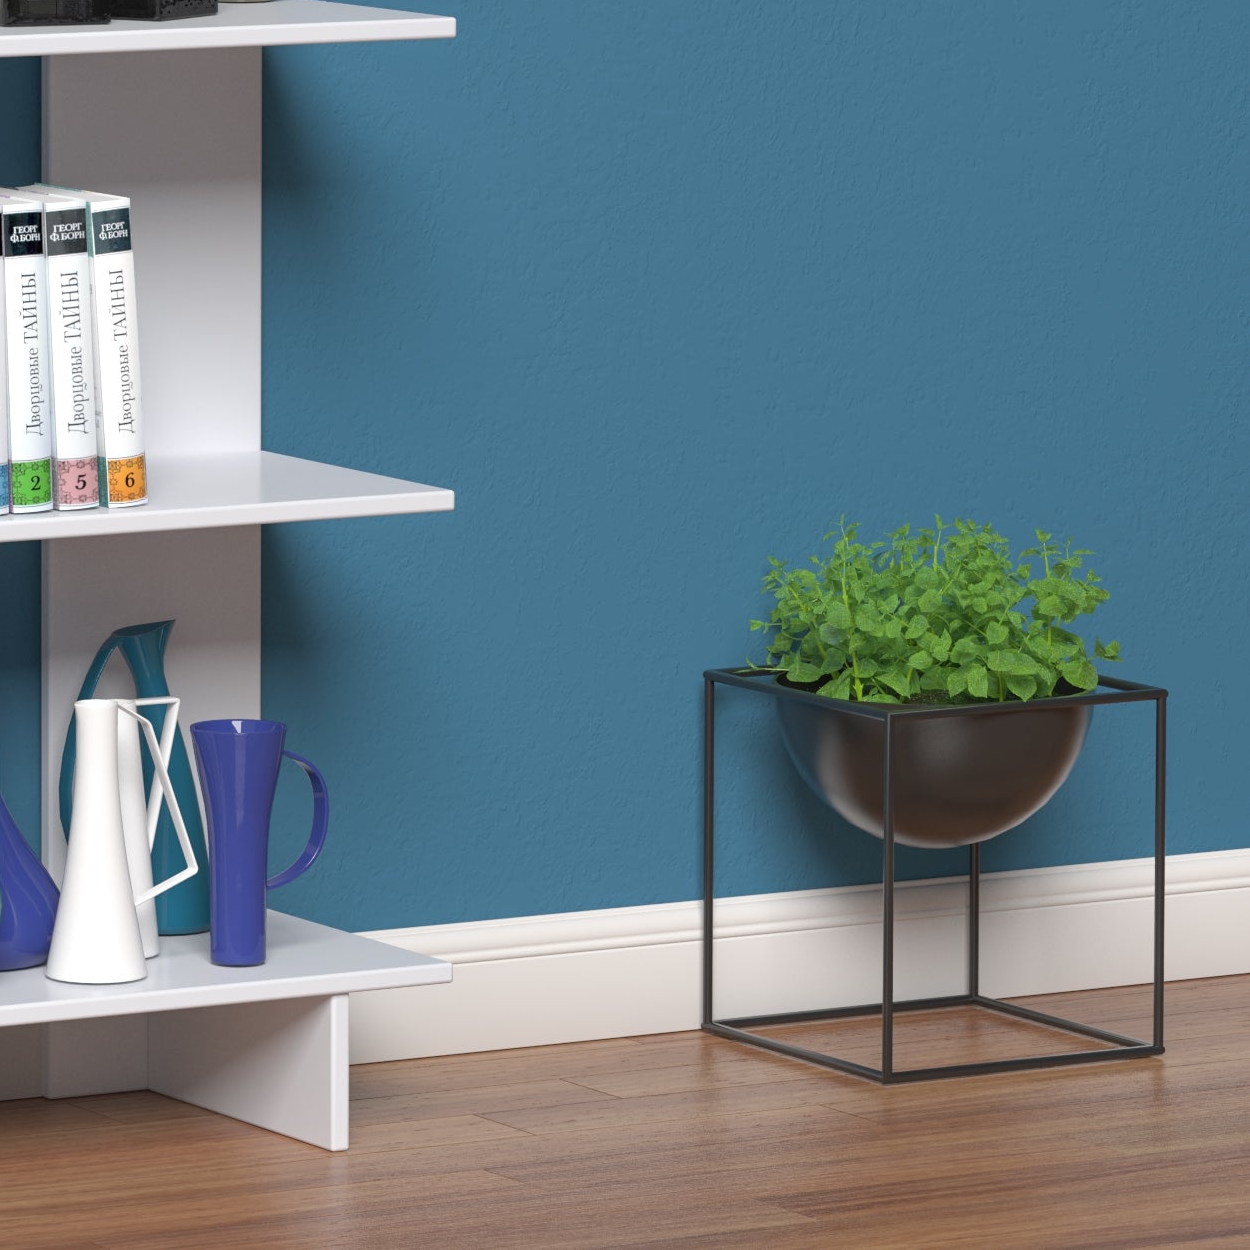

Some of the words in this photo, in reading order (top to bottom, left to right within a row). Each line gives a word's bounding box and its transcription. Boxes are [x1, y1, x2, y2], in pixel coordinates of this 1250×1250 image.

[13, 225, 38, 235] ГЕОРГ
[53, 222, 82, 233] ГЕОРГ
[101, 221, 125, 232] ГЕОРГ
[30, 475, 41, 491] 2
[75, 473, 87, 491] 5
[124, 471, 135, 487] 6
